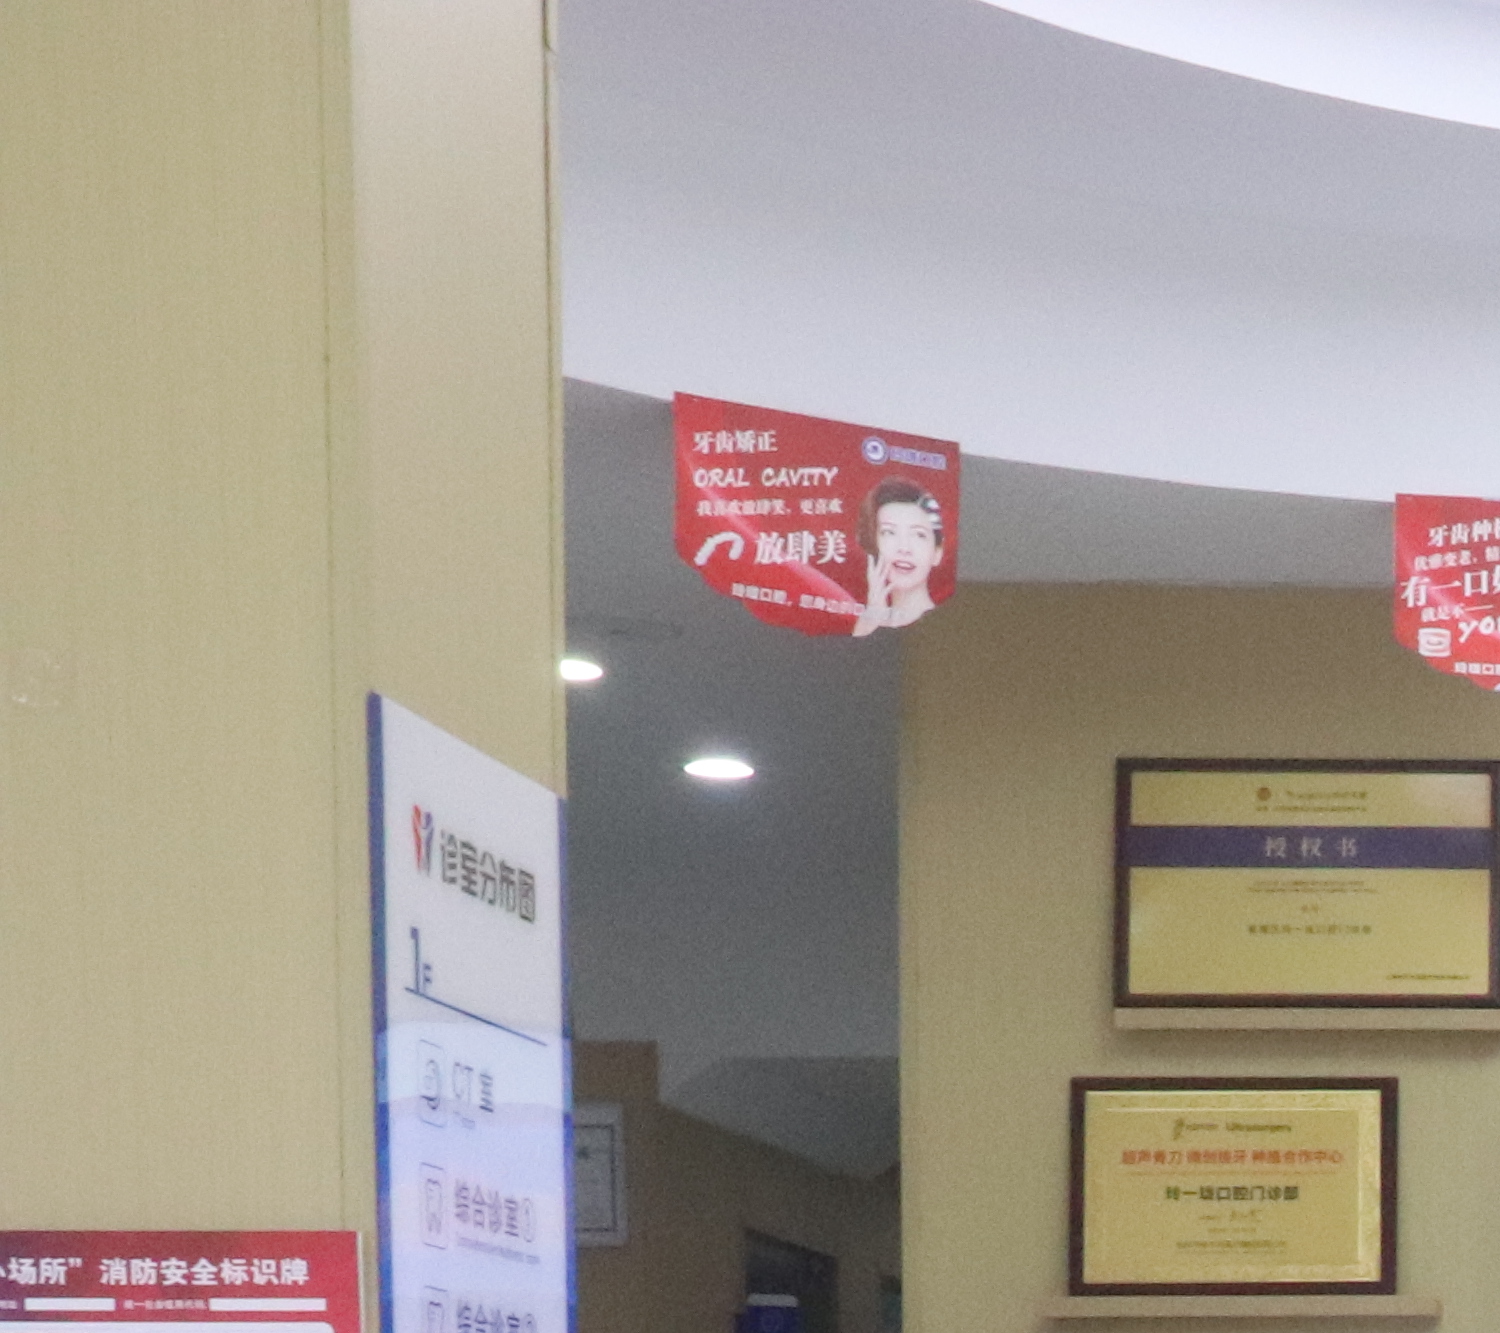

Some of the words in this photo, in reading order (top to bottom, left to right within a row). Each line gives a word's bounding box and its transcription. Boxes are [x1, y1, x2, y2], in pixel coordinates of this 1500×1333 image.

[692, 429, 778, 455] 牙齿矫正
[693, 467, 750, 488] ORAL
[761, 465, 839, 487] CAVITY
[755, 530, 848, 565] 放肆美
[1264, 836, 1358, 858] 授权书
[440, 828, 537, 925] 诊室分布图
[0, 1256, 310, 1287] 场所”消防安全标识牌
